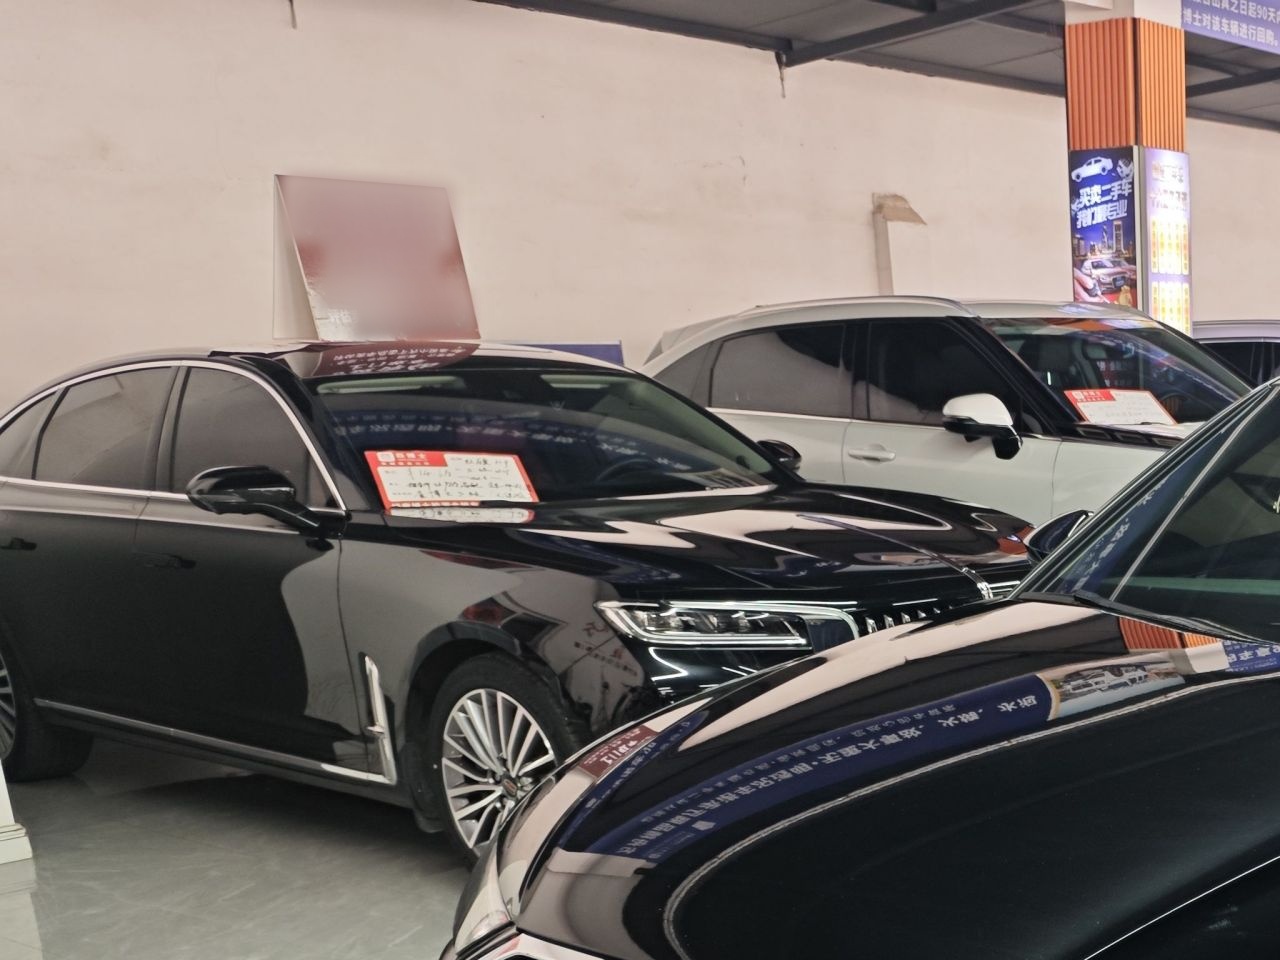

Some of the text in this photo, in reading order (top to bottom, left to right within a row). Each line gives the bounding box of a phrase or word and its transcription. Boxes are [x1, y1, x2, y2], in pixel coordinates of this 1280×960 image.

[1073, 179, 1132, 211] 买卖二手车
